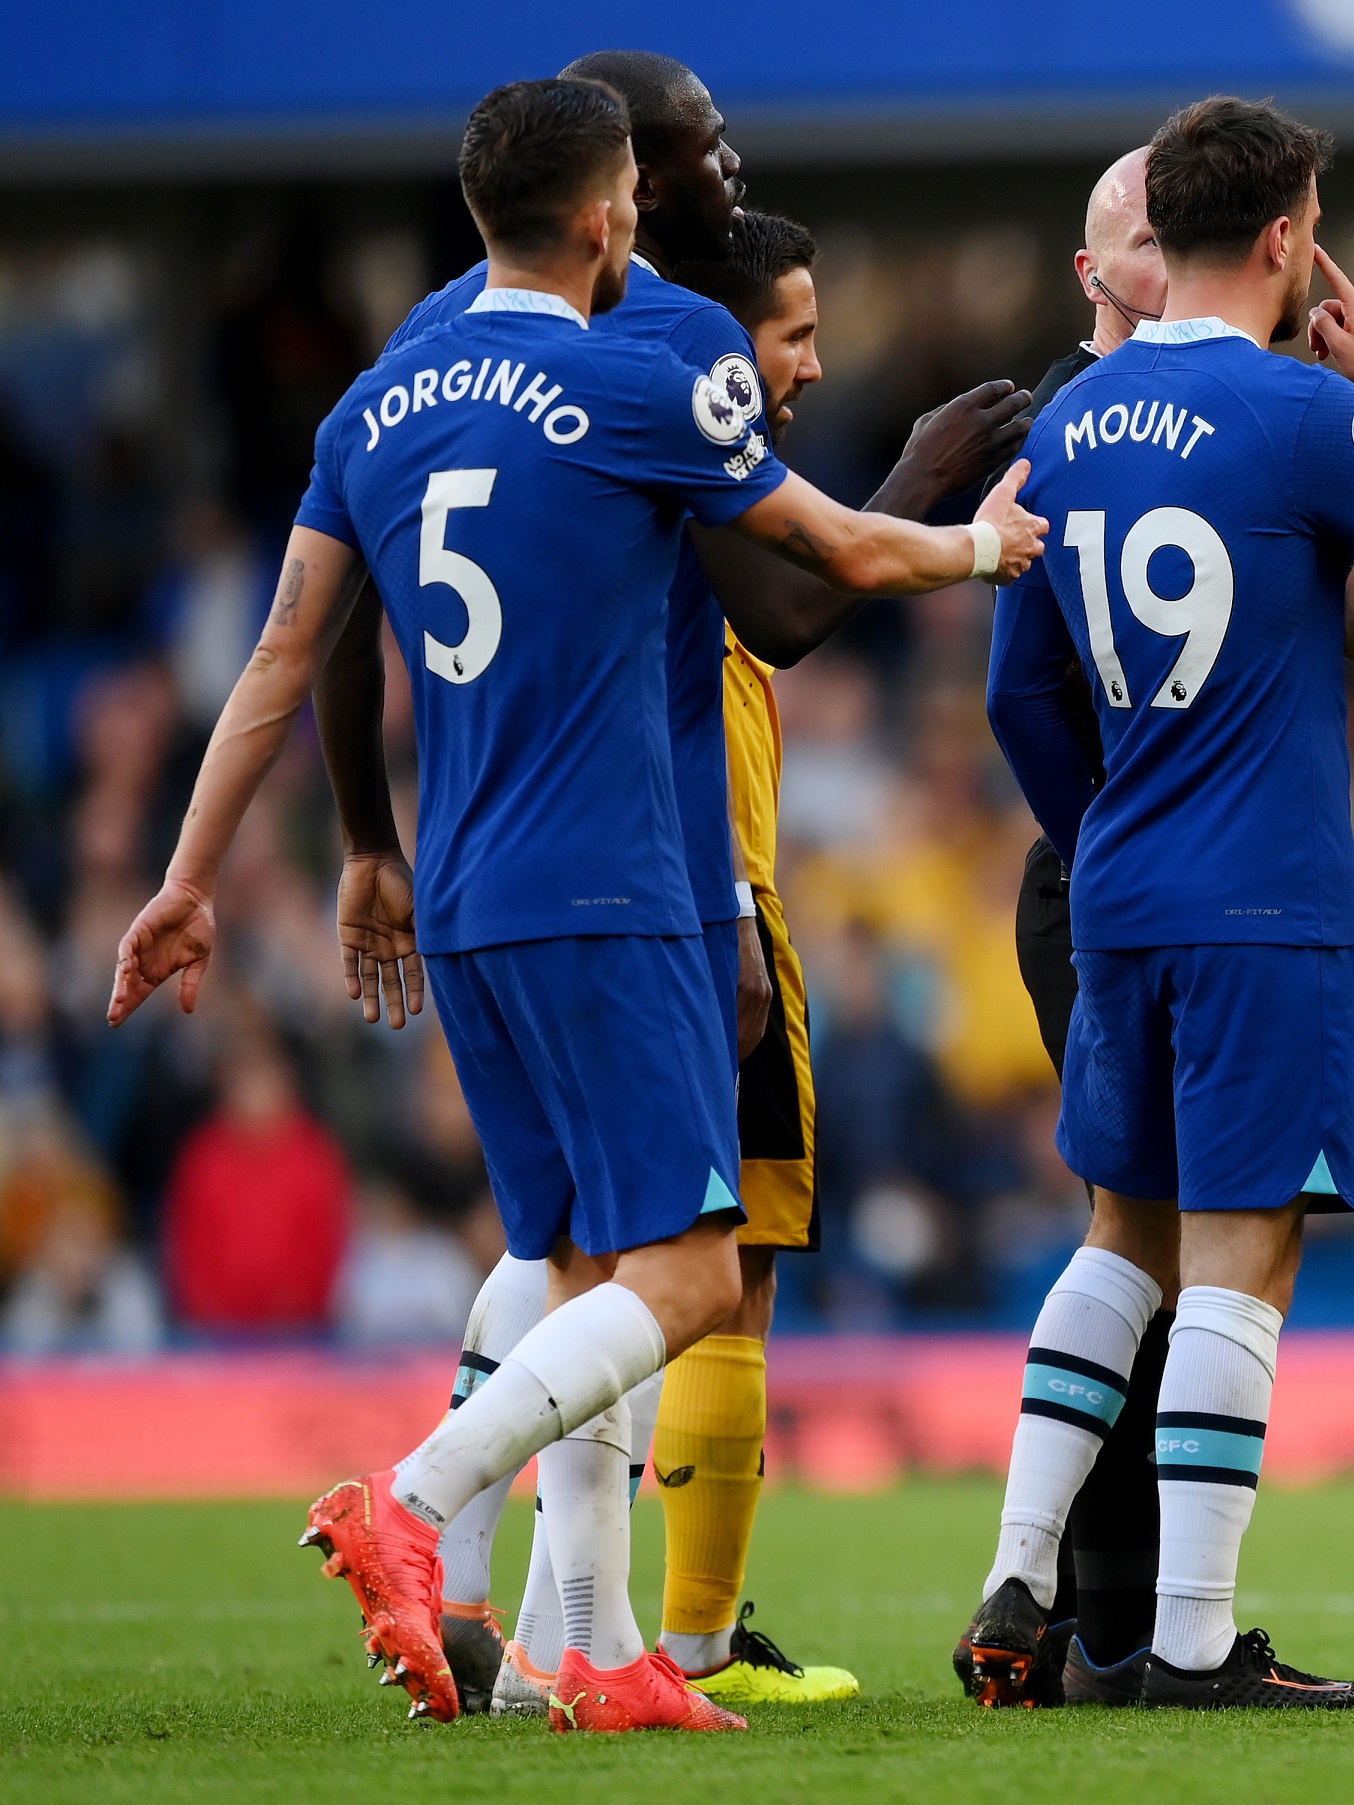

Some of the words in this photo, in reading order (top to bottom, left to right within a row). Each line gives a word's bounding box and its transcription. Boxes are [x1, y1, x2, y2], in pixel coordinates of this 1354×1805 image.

[362, 357, 590, 452] JORGINHO
[1064, 399, 1216, 462] MOUNT
[418, 468, 502, 685] 5
[1062, 506, 1235, 709] 19
[1047, 1378, 1103, 1405] CFC
[1156, 1439, 1200, 1453] CFC
